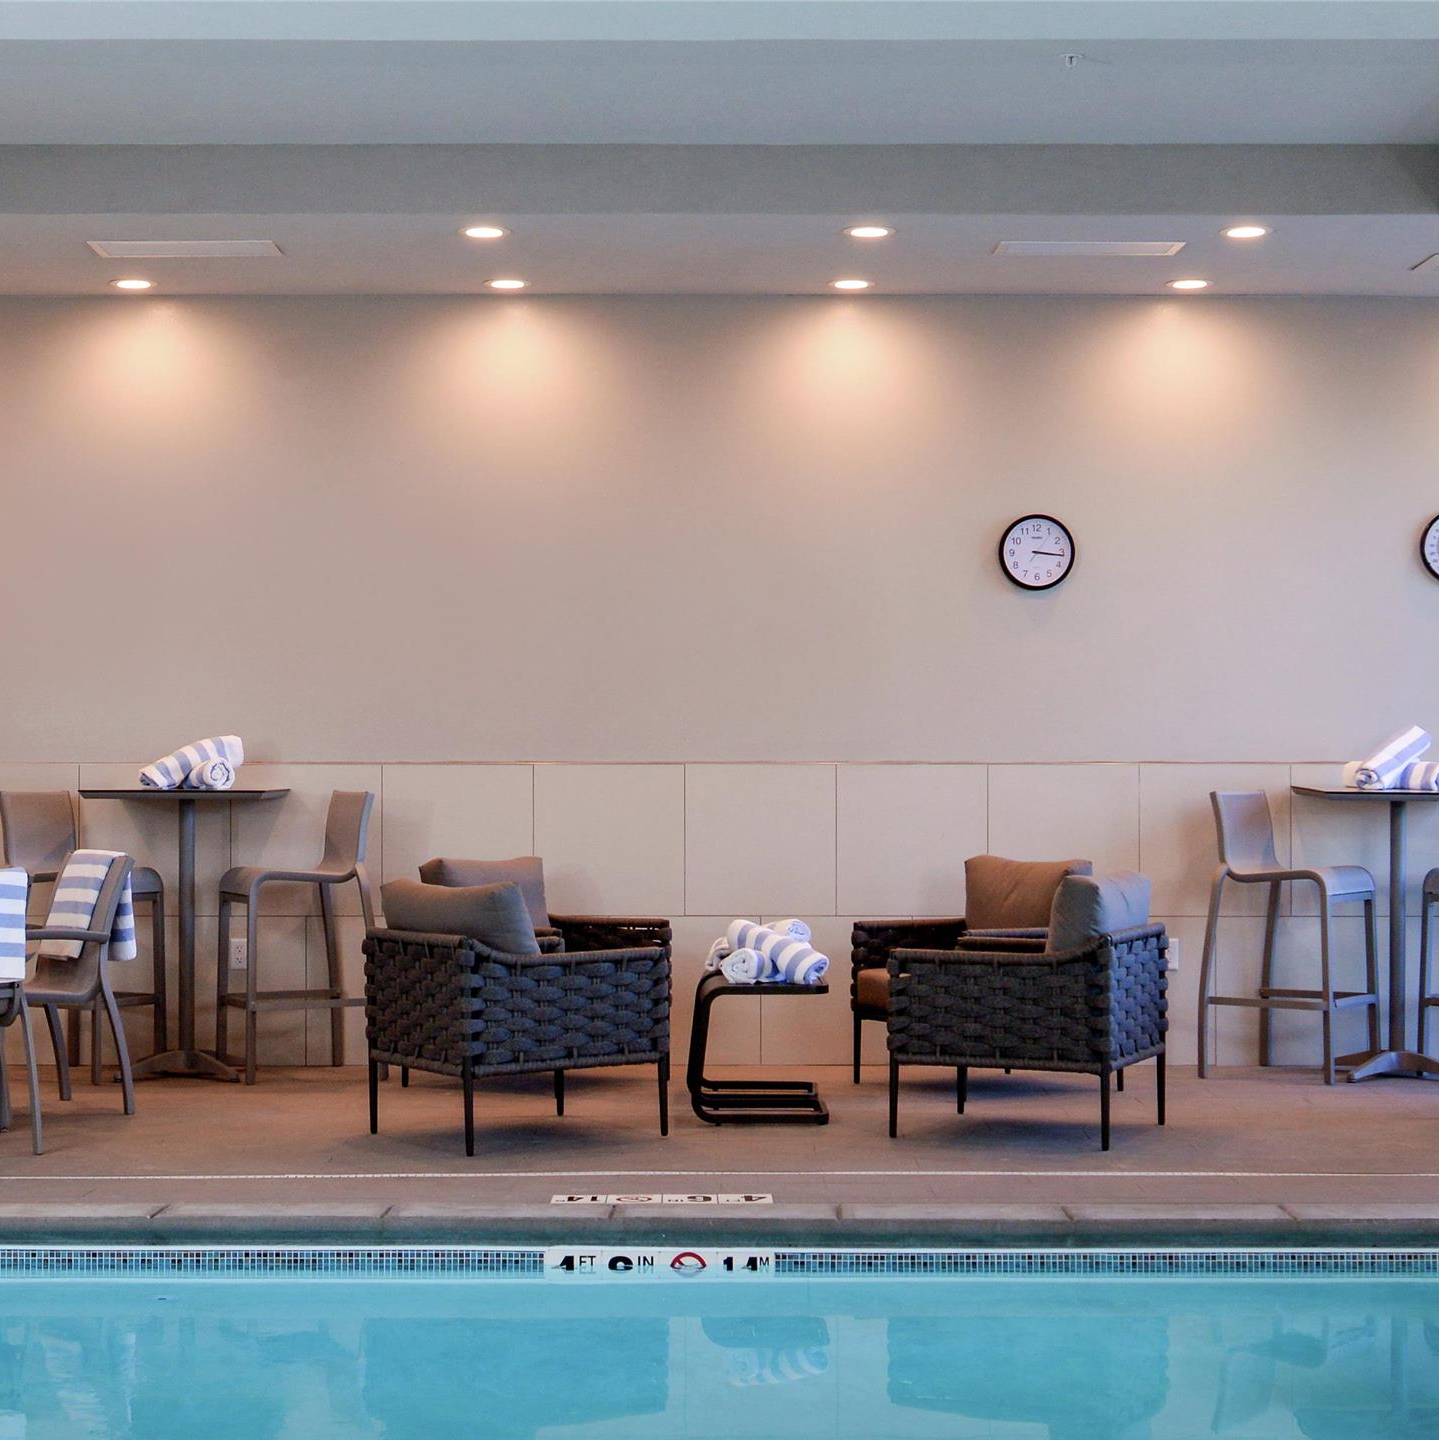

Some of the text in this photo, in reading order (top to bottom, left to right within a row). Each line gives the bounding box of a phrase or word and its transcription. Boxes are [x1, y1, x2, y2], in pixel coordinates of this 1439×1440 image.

[1032, 524, 1041, 532] 12
[1012, 537, 1021, 545] 10
[1009, 549, 1014, 557] 9
[1059, 548, 1064, 556] 3
[1013, 561, 1018, 569] 8
[1023, 569, 1028, 577] 7
[1047, 569, 1052, 577] 5
